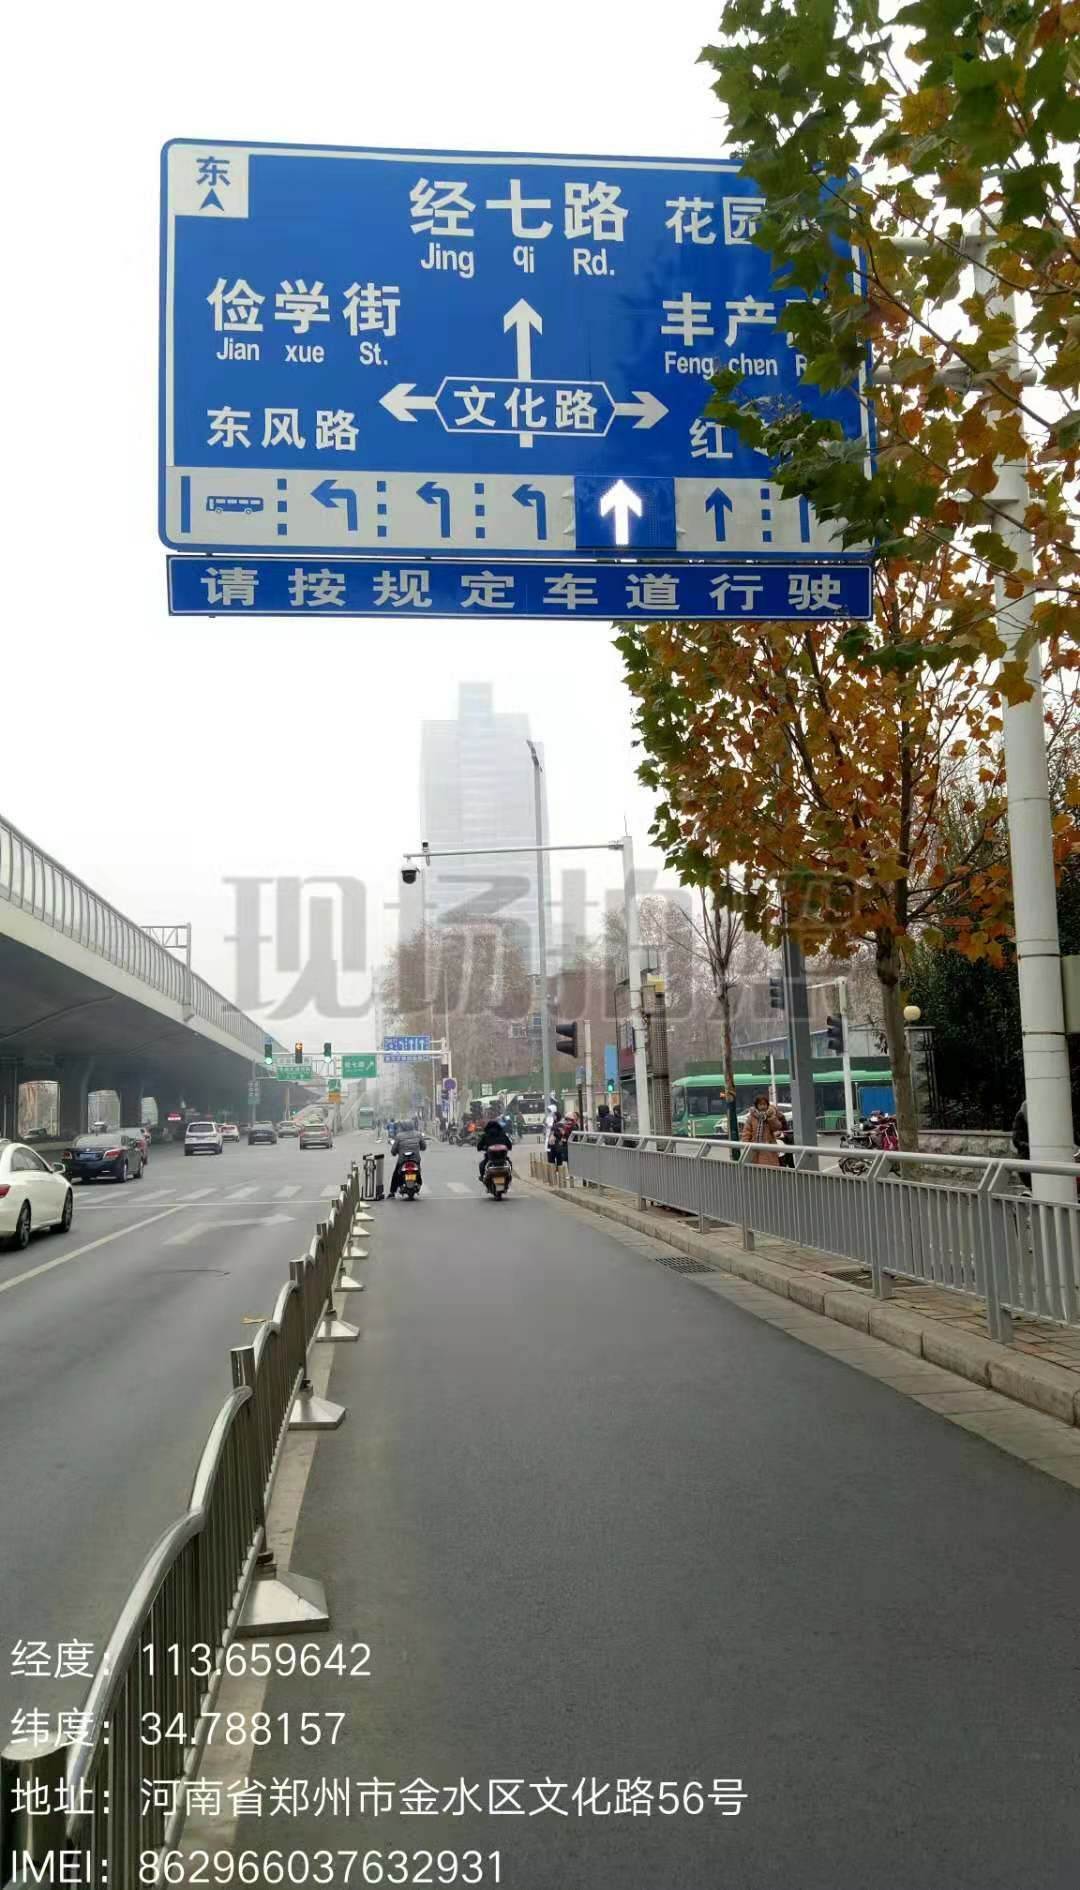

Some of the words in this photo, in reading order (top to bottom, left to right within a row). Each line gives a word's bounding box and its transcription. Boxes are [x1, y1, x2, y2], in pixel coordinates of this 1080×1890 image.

[195, 154, 230, 184] 东
[409, 178, 629, 241] 经七路
[419, 243, 476, 279] Jing
[511, 243, 536, 275] qi
[572, 245, 616, 277] Rd.
[206, 278, 402, 338] 俭学街
[215, 336, 261, 363] Jian
[284, 343, 326, 364] xue
[359, 339, 390, 366] St.
[664, 350, 716, 380] Feng
[206, 406, 361, 452] 东风路
[453, 386, 600, 432] 文化路
[200, 566, 846, 612] 请按规定车道行驶
